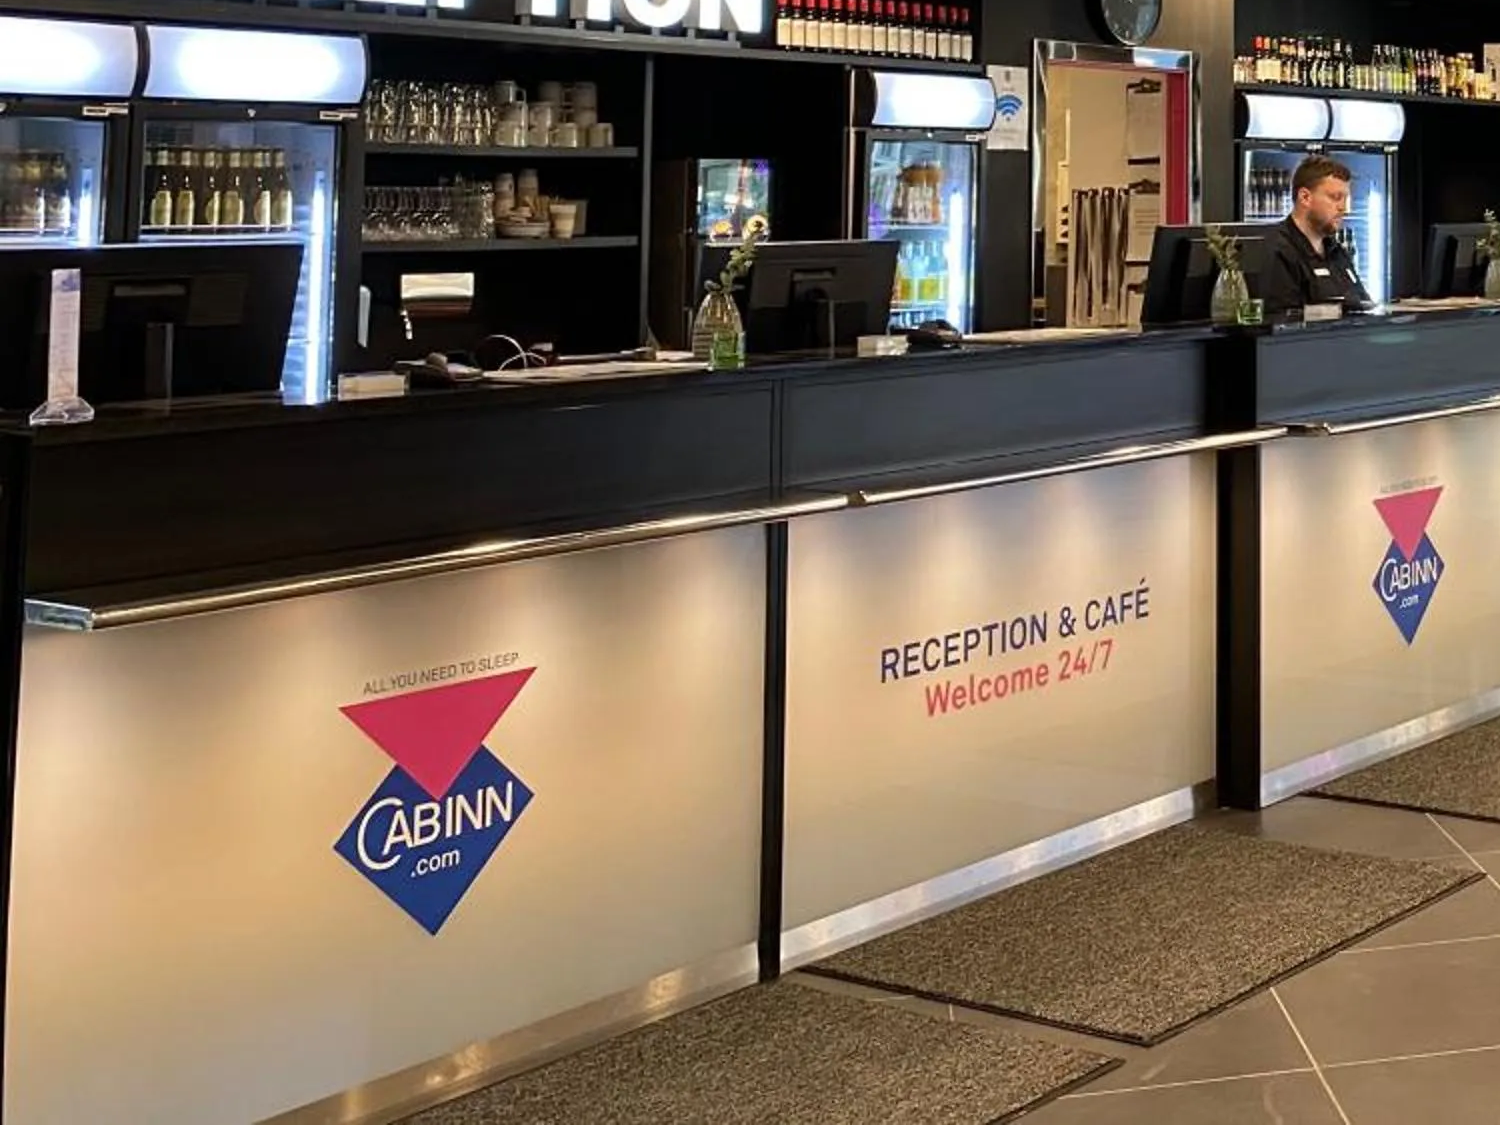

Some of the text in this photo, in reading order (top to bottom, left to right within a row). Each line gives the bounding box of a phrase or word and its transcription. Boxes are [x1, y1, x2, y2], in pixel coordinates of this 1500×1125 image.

[1380, 556, 1437, 602] CABINN
[880, 577, 1150, 684] RECEPTION & CAFÉ
[363, 652, 519, 695] ALL YOU NEED TO SLEEP
[925, 638, 1113, 718] Welcome 24/7
[357, 780, 513, 870] CABINN
[410, 849, 461, 878] .com
